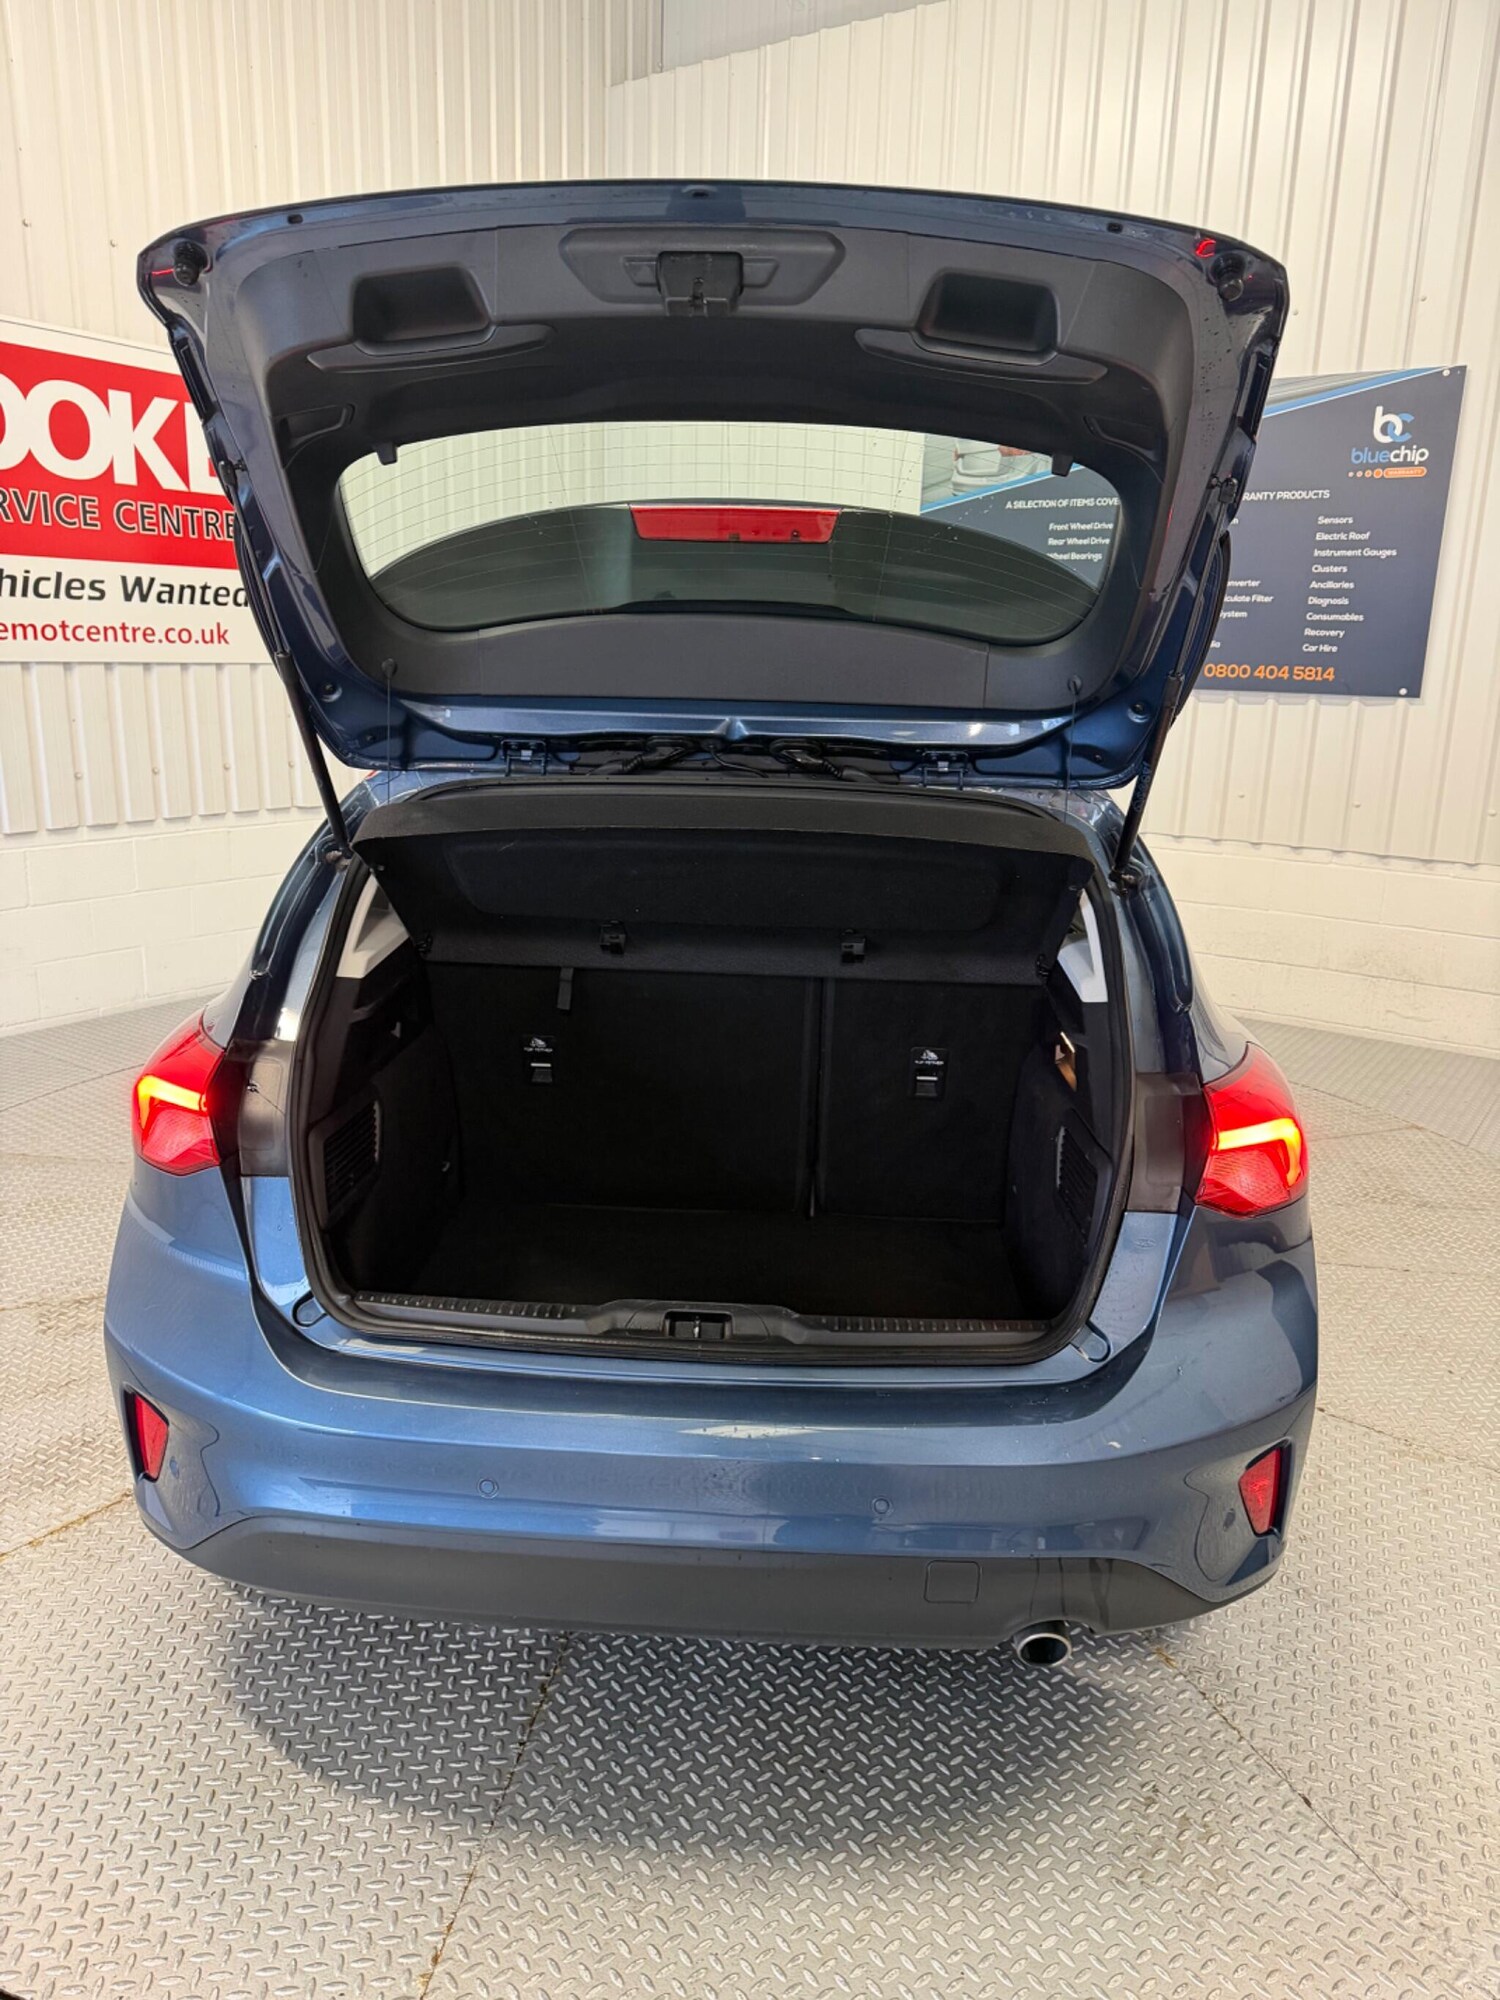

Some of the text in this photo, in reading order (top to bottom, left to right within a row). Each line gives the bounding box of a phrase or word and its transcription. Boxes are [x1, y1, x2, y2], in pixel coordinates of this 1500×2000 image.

[1351, 445, 1430, 465] bluechip
[1276, 489, 1330, 500] PRODUCTS
[1004, 501, 1012, 509] A
[1013, 500, 1057, 509] SELECTION
[1058, 498, 1069, 507] OF
[1070, 498, 1095, 507] ITEMS
[114, 500, 235, 541] CENTRE
[1048, 521, 1114, 531] Front Wheel Drive
[1317, 516, 1353, 525] Sensors
[1047, 537, 1110, 546] Rear Wheel Drive
[1315, 531, 1370, 541] Electric Roof
[1070, 552, 1103, 563] Bearings
[1313, 547, 1398, 559] Instrument Gauges
[1311, 564, 1348, 573] Clusters
[0, 568, 250, 607] hicles Wanted
[1309, 580, 1355, 590] Ancillaries
[1251, 594, 1274, 603] Filter
[1307, 596, 1350, 607] Diagnosis
[1306, 612, 1364, 622] Consumables
[0, 620, 230, 646] emotcentre.co.uk
[1304, 628, 1346, 639] Recovery
[1302, 643, 1338, 653] Car Hire
[1203, 663, 1335, 681] 0800 404 5814
